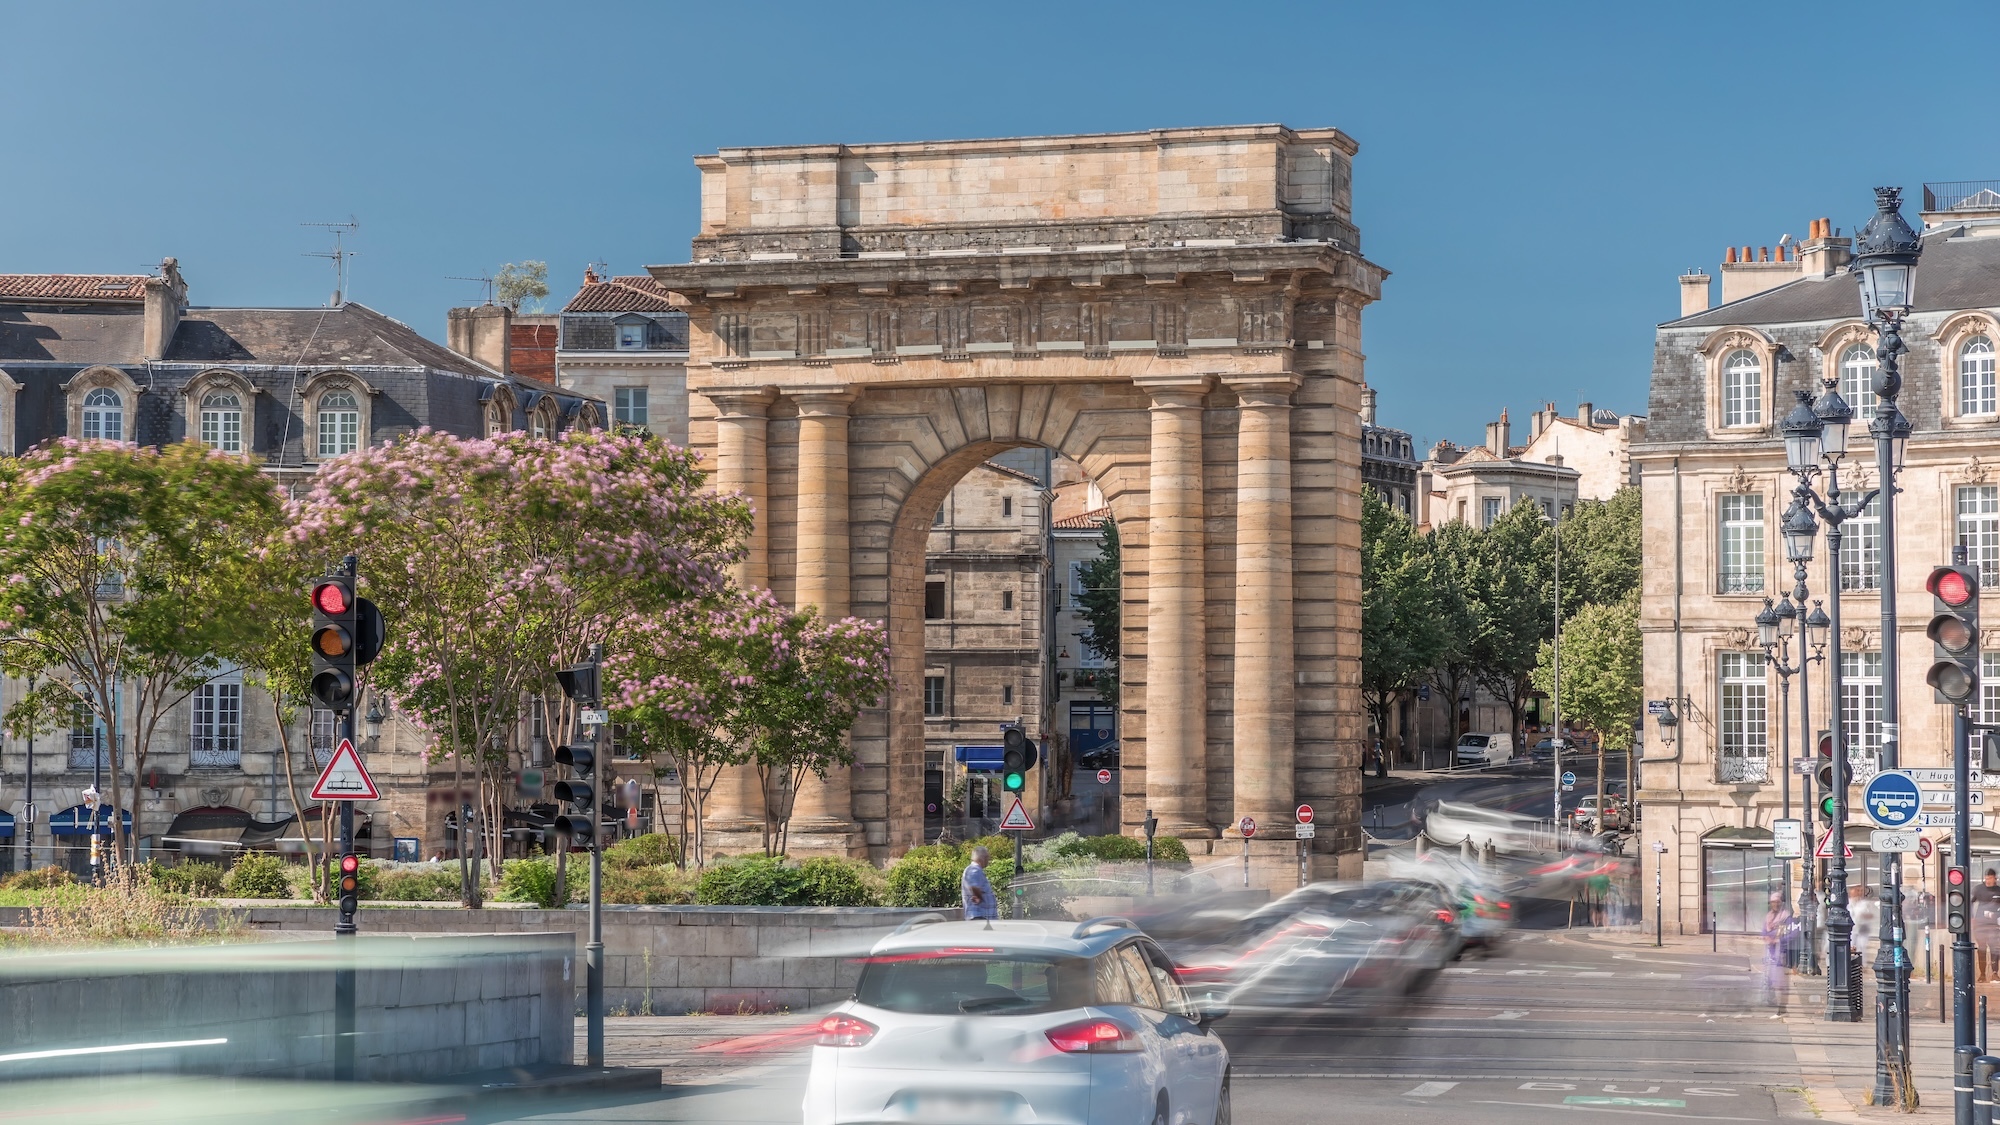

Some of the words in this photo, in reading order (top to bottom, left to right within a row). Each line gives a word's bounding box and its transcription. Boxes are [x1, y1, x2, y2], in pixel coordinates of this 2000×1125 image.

[1915, 771, 1924, 780] V.
[1929, 771, 1955, 782] Hugo
[1516, 1082, 1740, 1097] BUS
